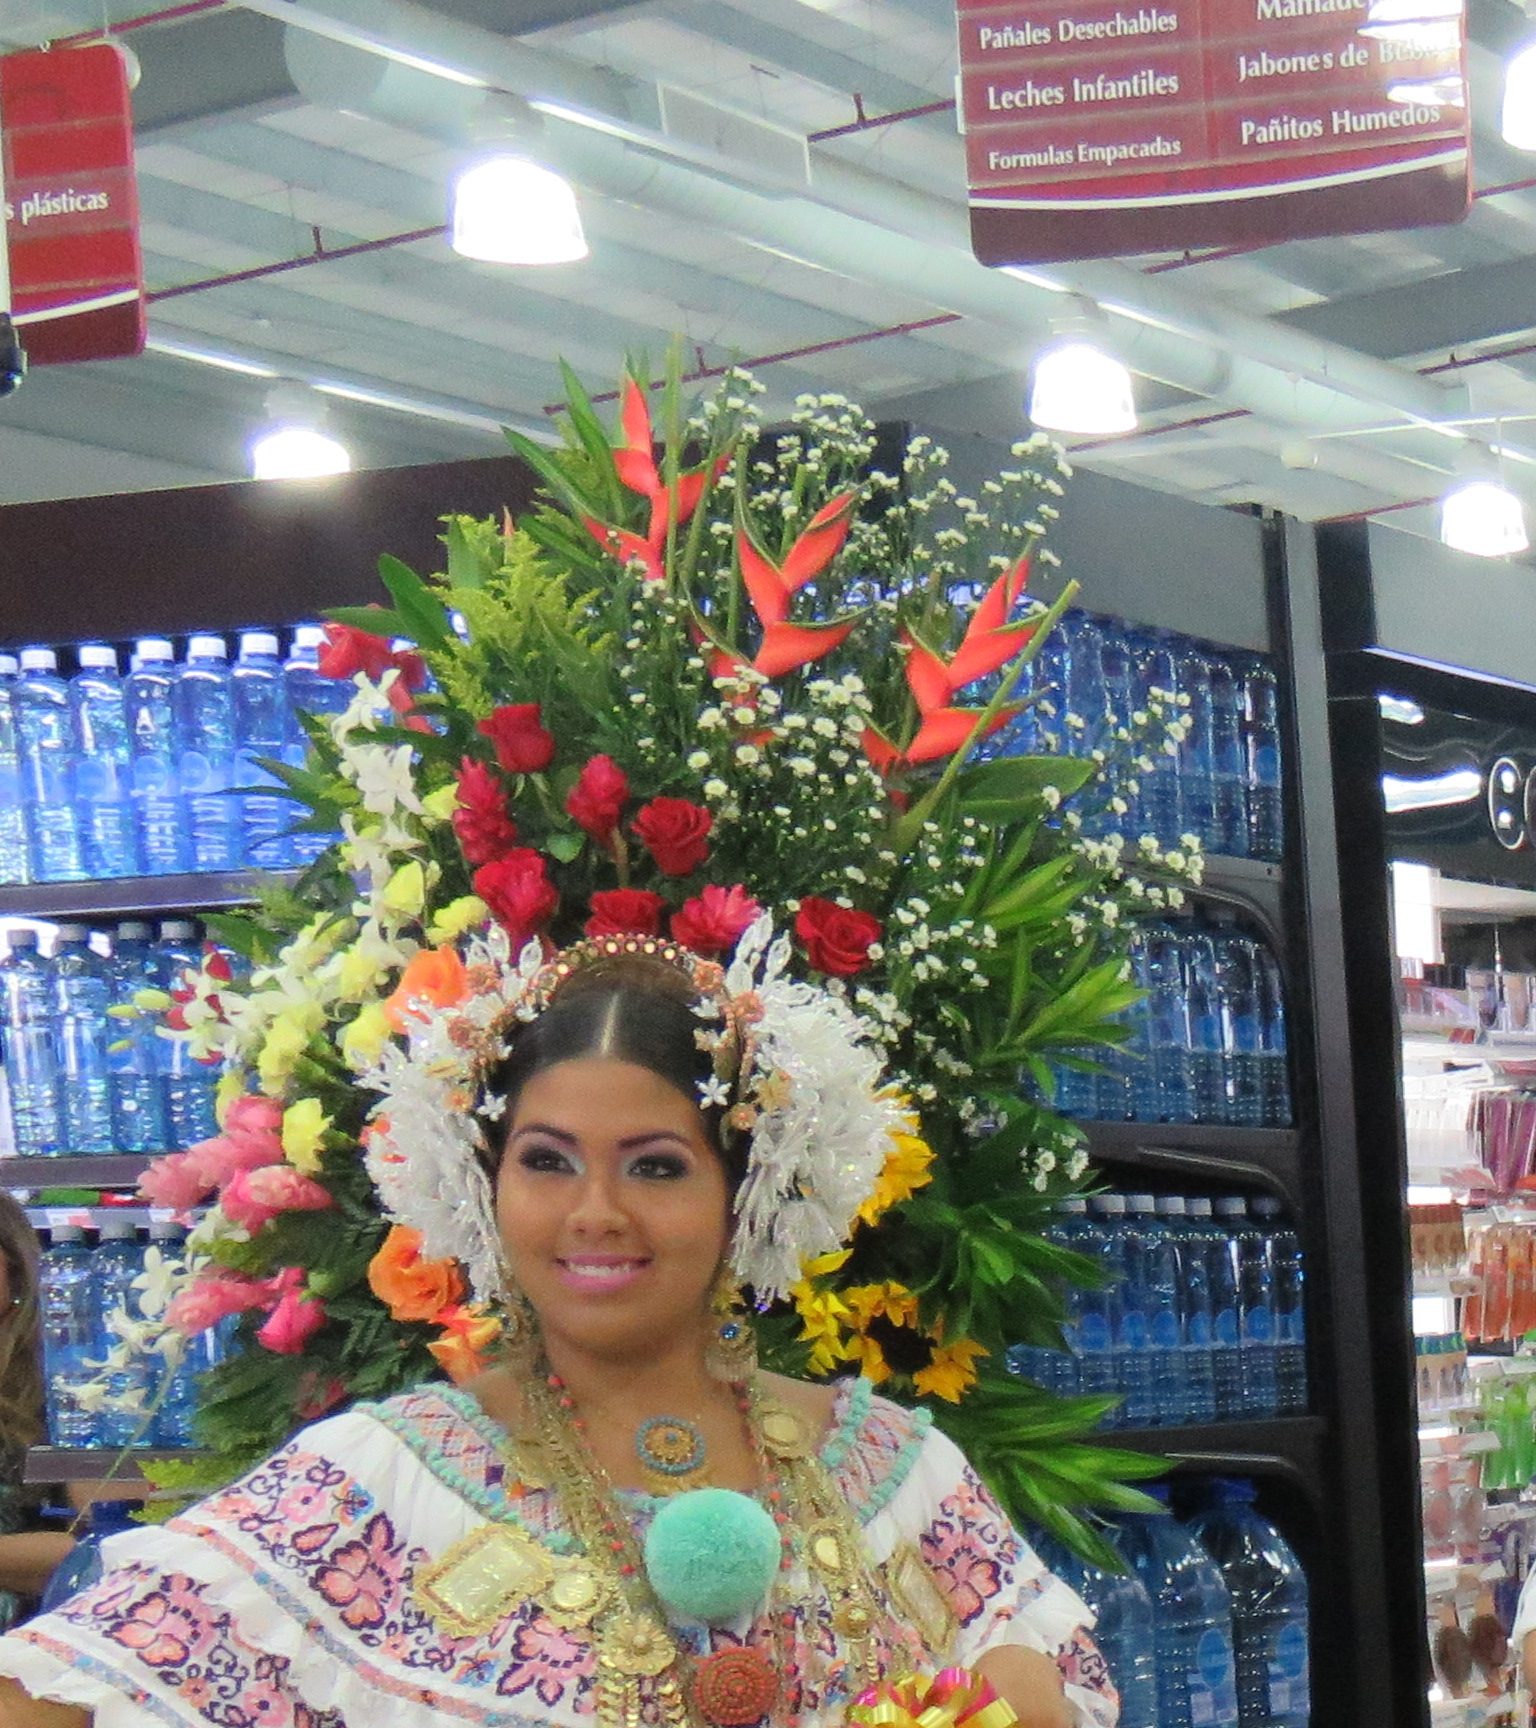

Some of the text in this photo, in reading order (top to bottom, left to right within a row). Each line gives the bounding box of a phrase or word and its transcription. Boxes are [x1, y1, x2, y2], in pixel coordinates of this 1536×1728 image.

[980, 10, 1178, 50] Pañales Desechables
[1238, 51, 1334, 83] Jabones
[1340, 43, 1368, 67] de
[988, 69, 1180, 111] Leches Infantiles
[1241, 103, 1441, 145] Pañitos Humedos
[988, 136, 1182, 171] Formulas Empacadas
[21, 188, 109, 226] plásticas
